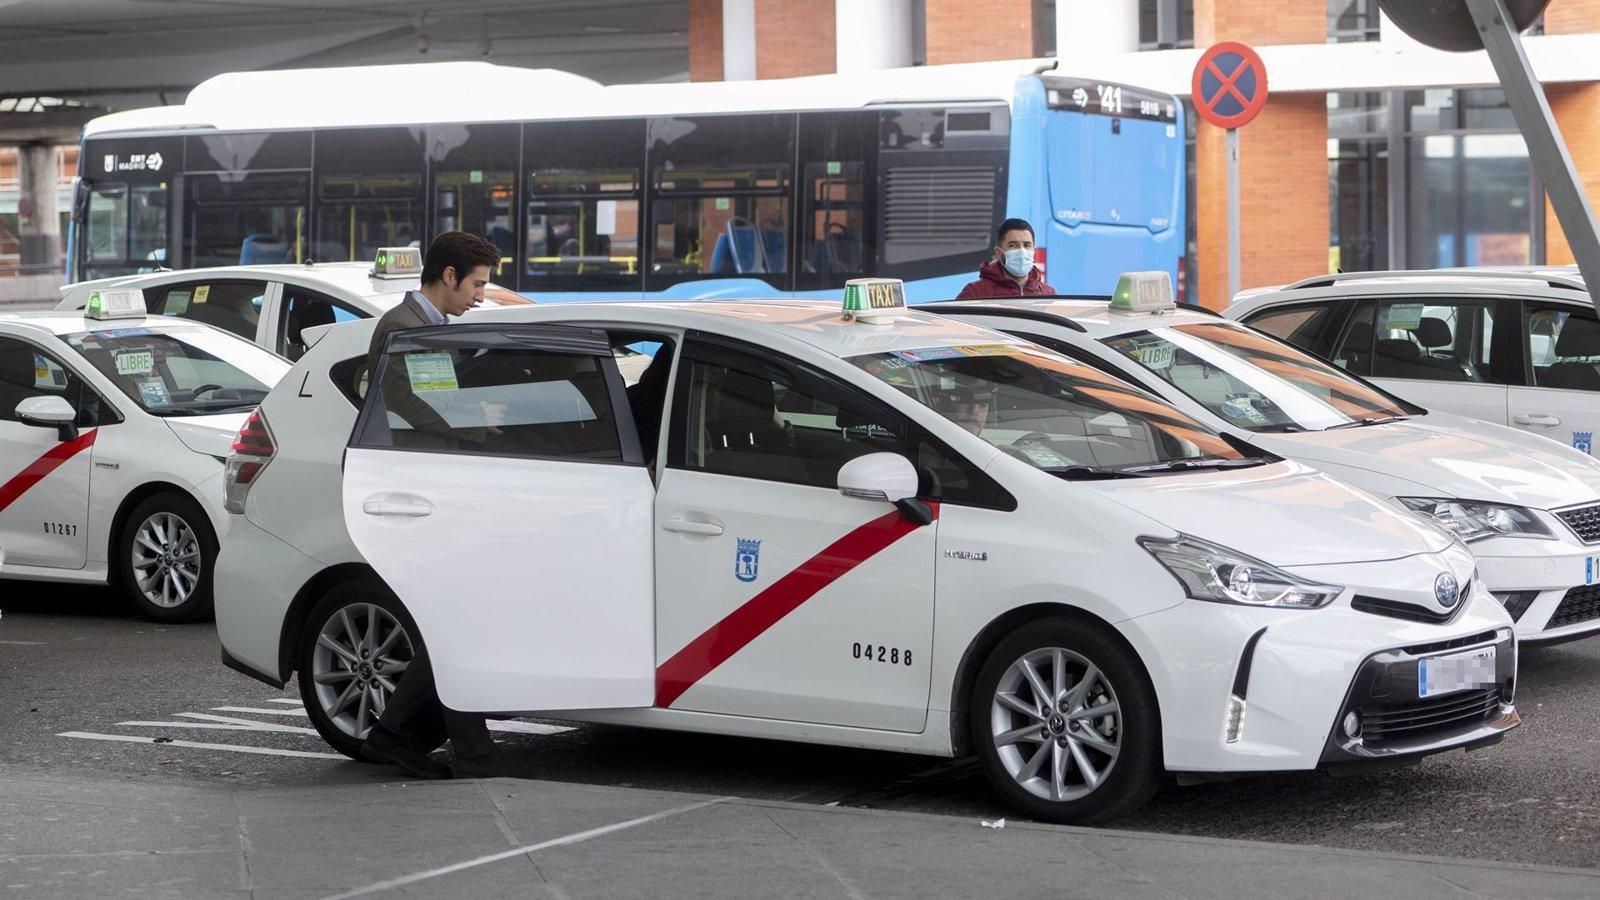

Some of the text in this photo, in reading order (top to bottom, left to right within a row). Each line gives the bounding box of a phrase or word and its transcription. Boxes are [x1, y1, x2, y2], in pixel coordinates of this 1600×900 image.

[118, 162, 146, 170] MADRID
[396, 253, 414, 268] TAXI
[868, 284, 895, 307] TAXI
[120, 354, 150, 371] LIBRE
[1142, 346, 1171, 363] LIBRE
[43, 522, 77, 536] 01267
[852, 642, 913, 667] 04288
